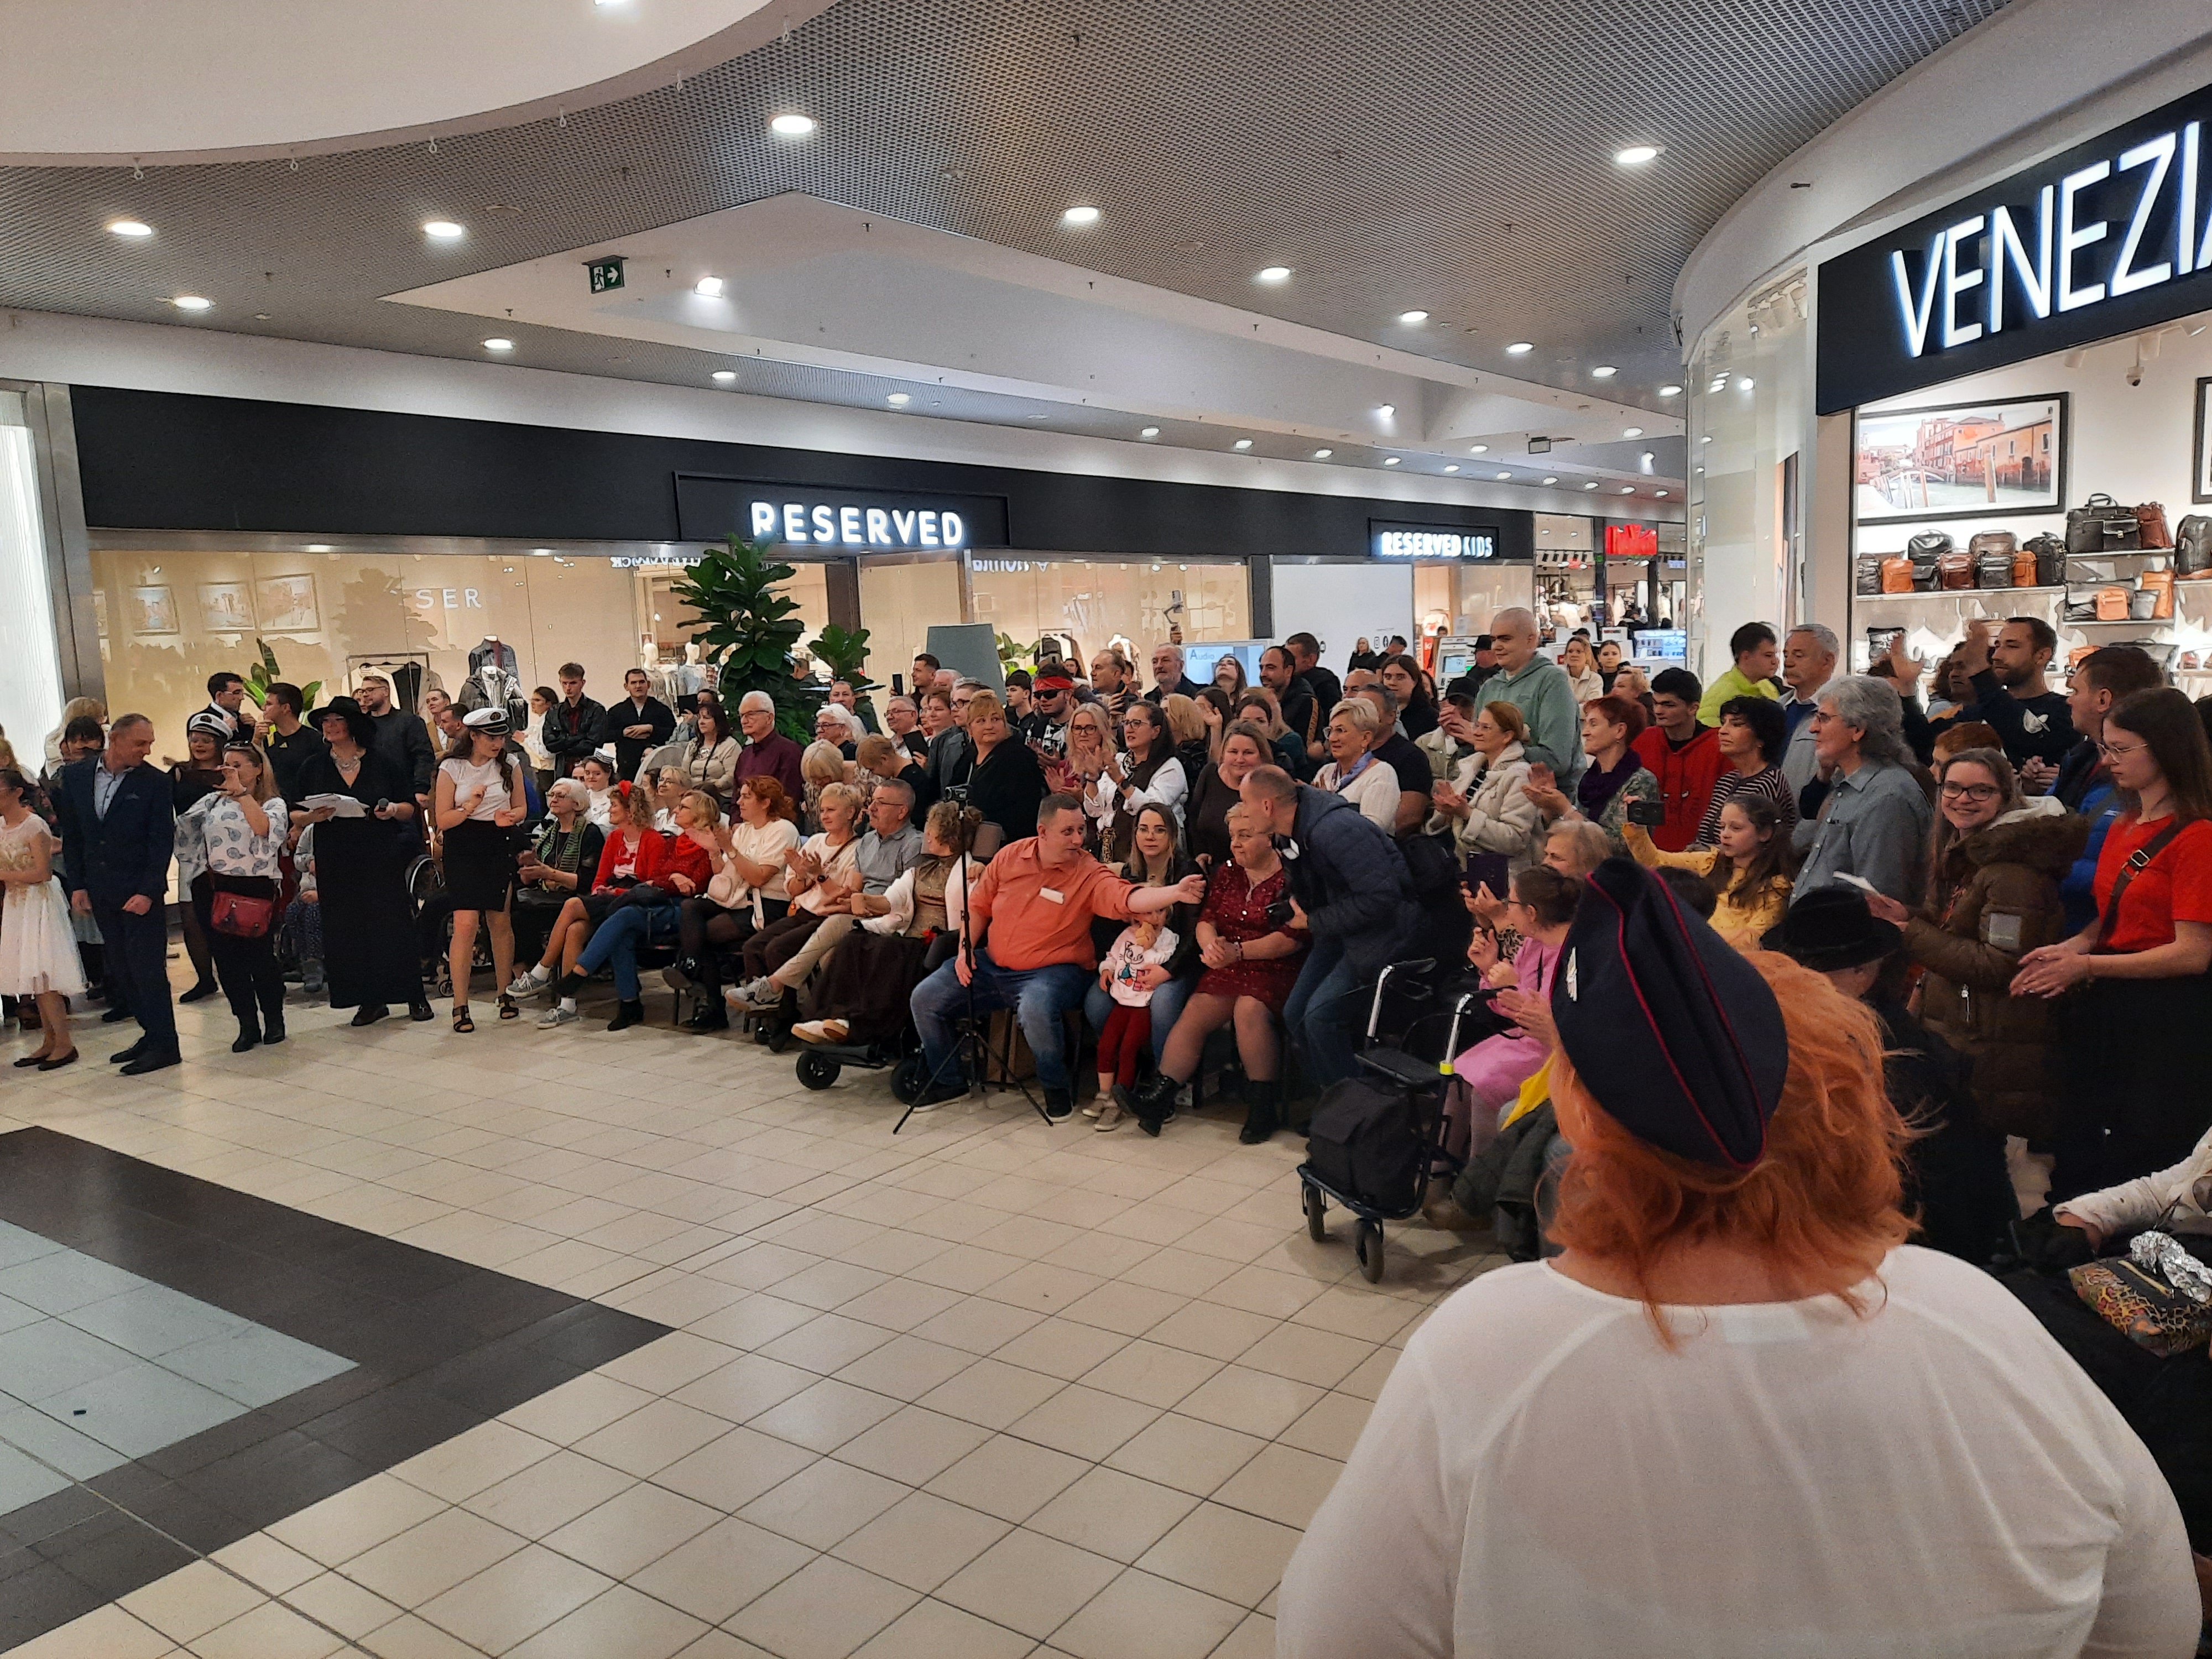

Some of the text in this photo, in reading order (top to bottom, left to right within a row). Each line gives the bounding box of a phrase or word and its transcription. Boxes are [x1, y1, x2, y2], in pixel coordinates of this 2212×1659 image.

[1892, 121, 2212, 357] VENEZI
[751, 501, 963, 545] RESERVED
[1381, 531, 1493, 557] RESERVED KIDS
